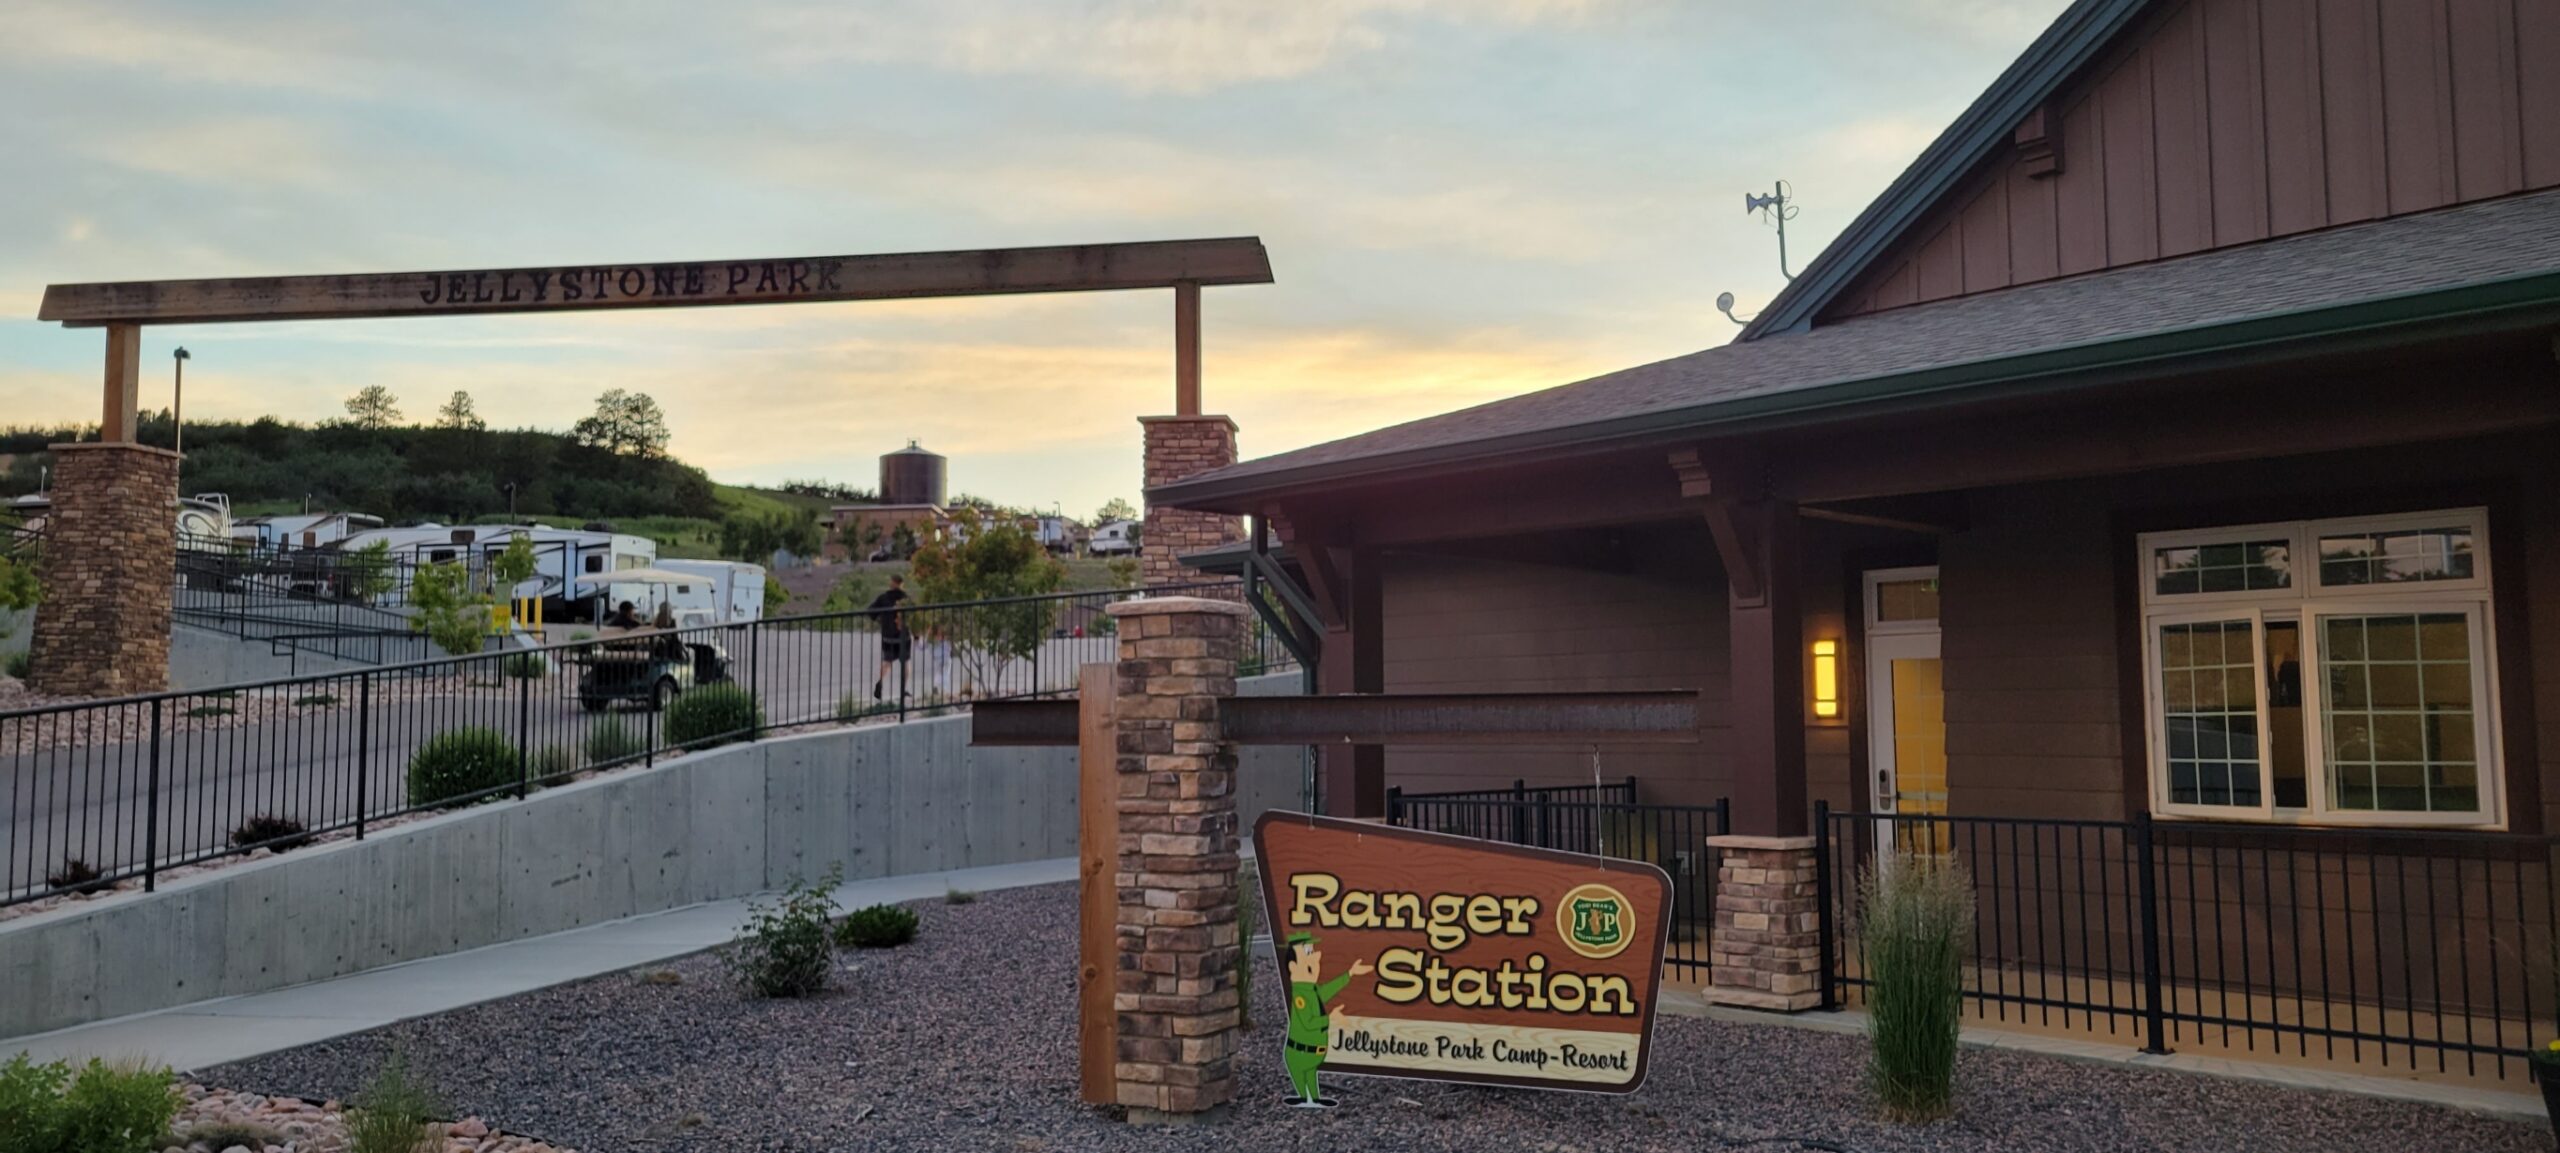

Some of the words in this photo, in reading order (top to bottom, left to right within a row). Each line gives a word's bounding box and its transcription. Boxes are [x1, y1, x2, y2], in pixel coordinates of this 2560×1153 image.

[420, 265, 704, 304] JELLYSTONE
[726, 261, 842, 294] PARK
[1290, 873, 1538, 950] Ranger
[1376, 949, 1635, 1014] Station
[1332, 1029, 1429, 1060] Jellystone
[1437, 1036, 1484, 1060] Park
[1492, 1039, 1628, 1071] Camp-Resort
